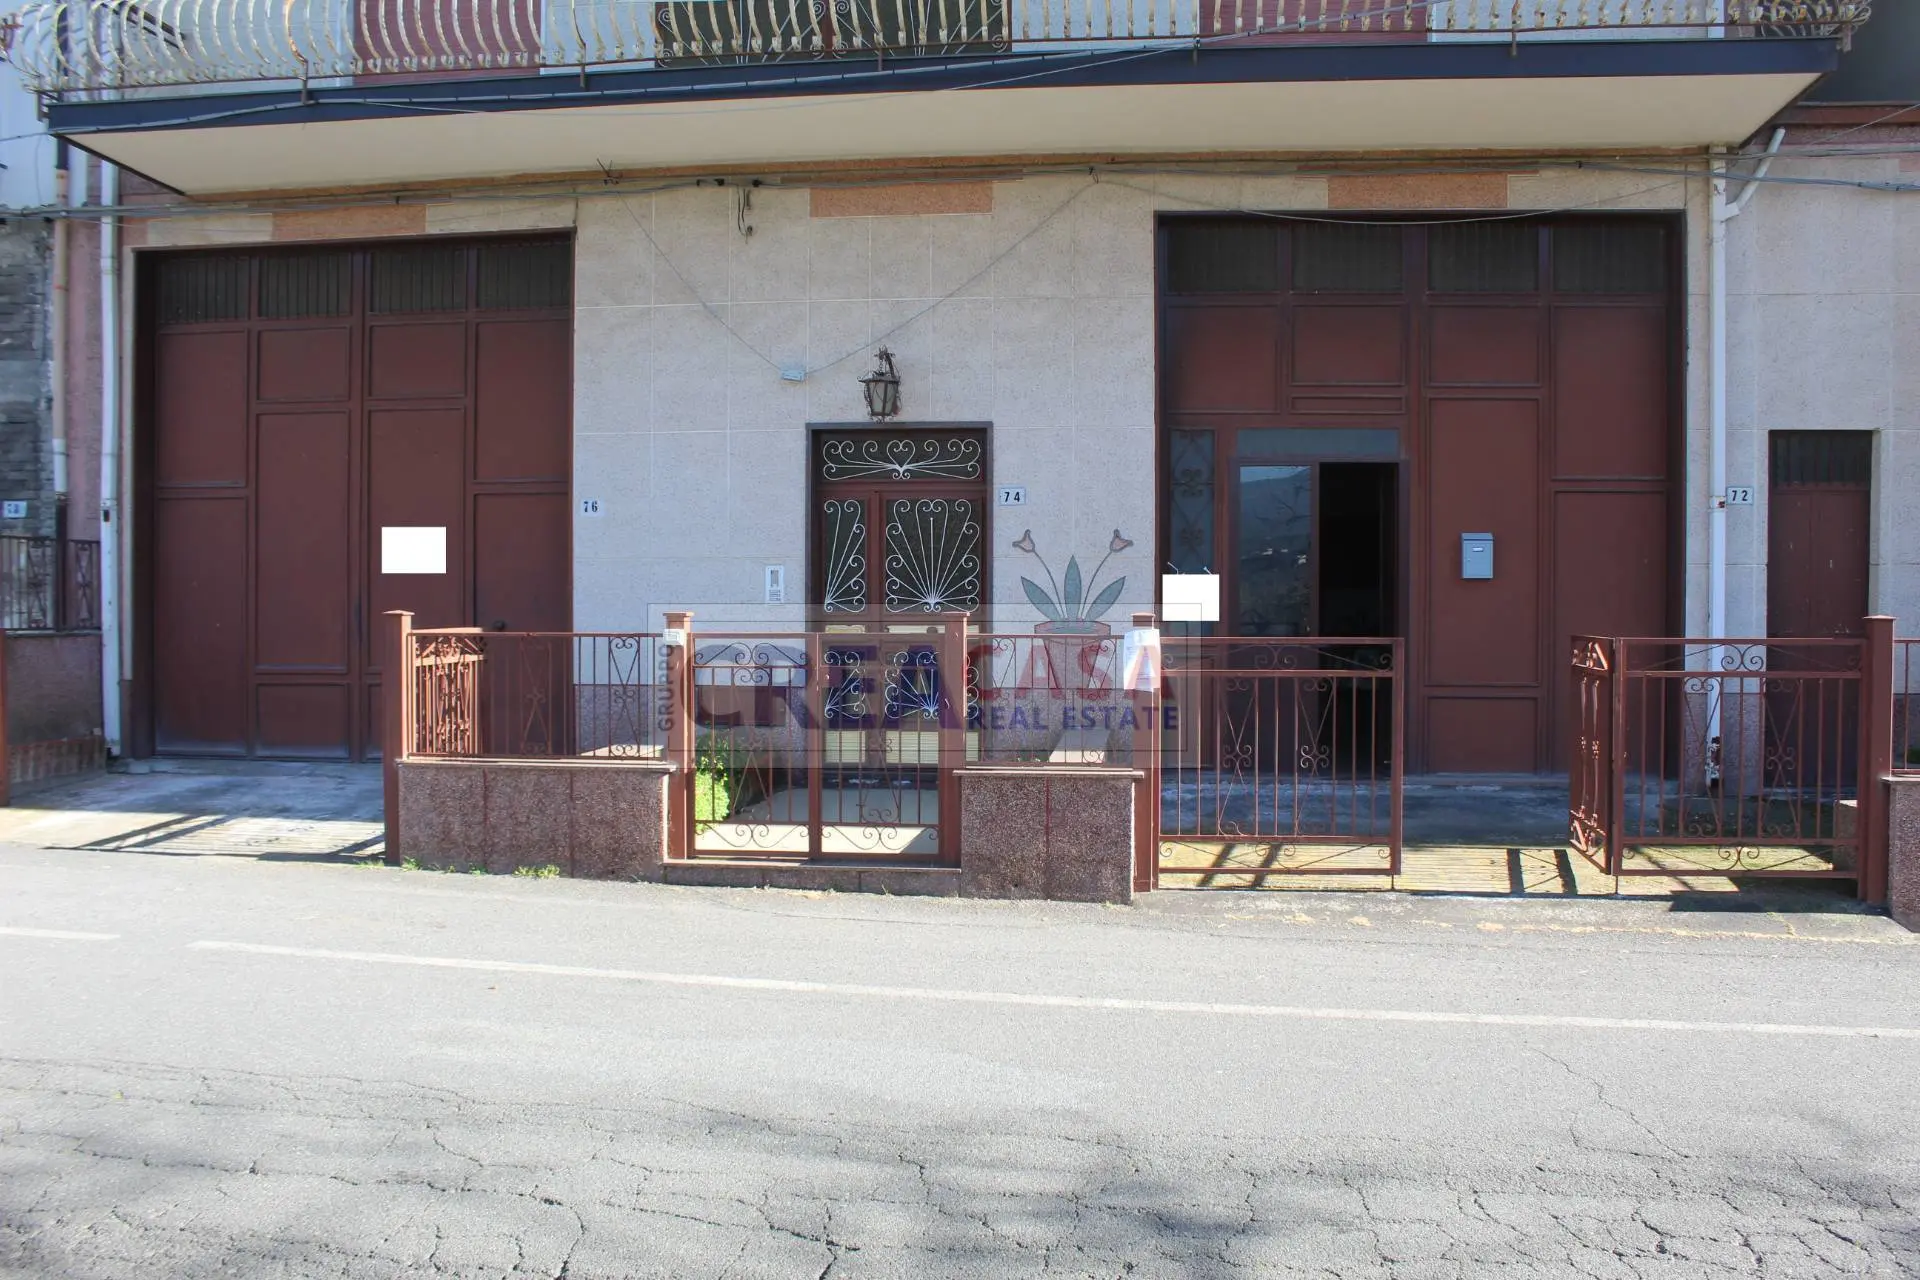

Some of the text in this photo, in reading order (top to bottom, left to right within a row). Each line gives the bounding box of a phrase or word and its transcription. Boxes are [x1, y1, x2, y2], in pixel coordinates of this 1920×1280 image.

[1004, 491, 1021, 503] 74
[1731, 489, 1749, 502] 72
[583, 500, 599, 513] 76
